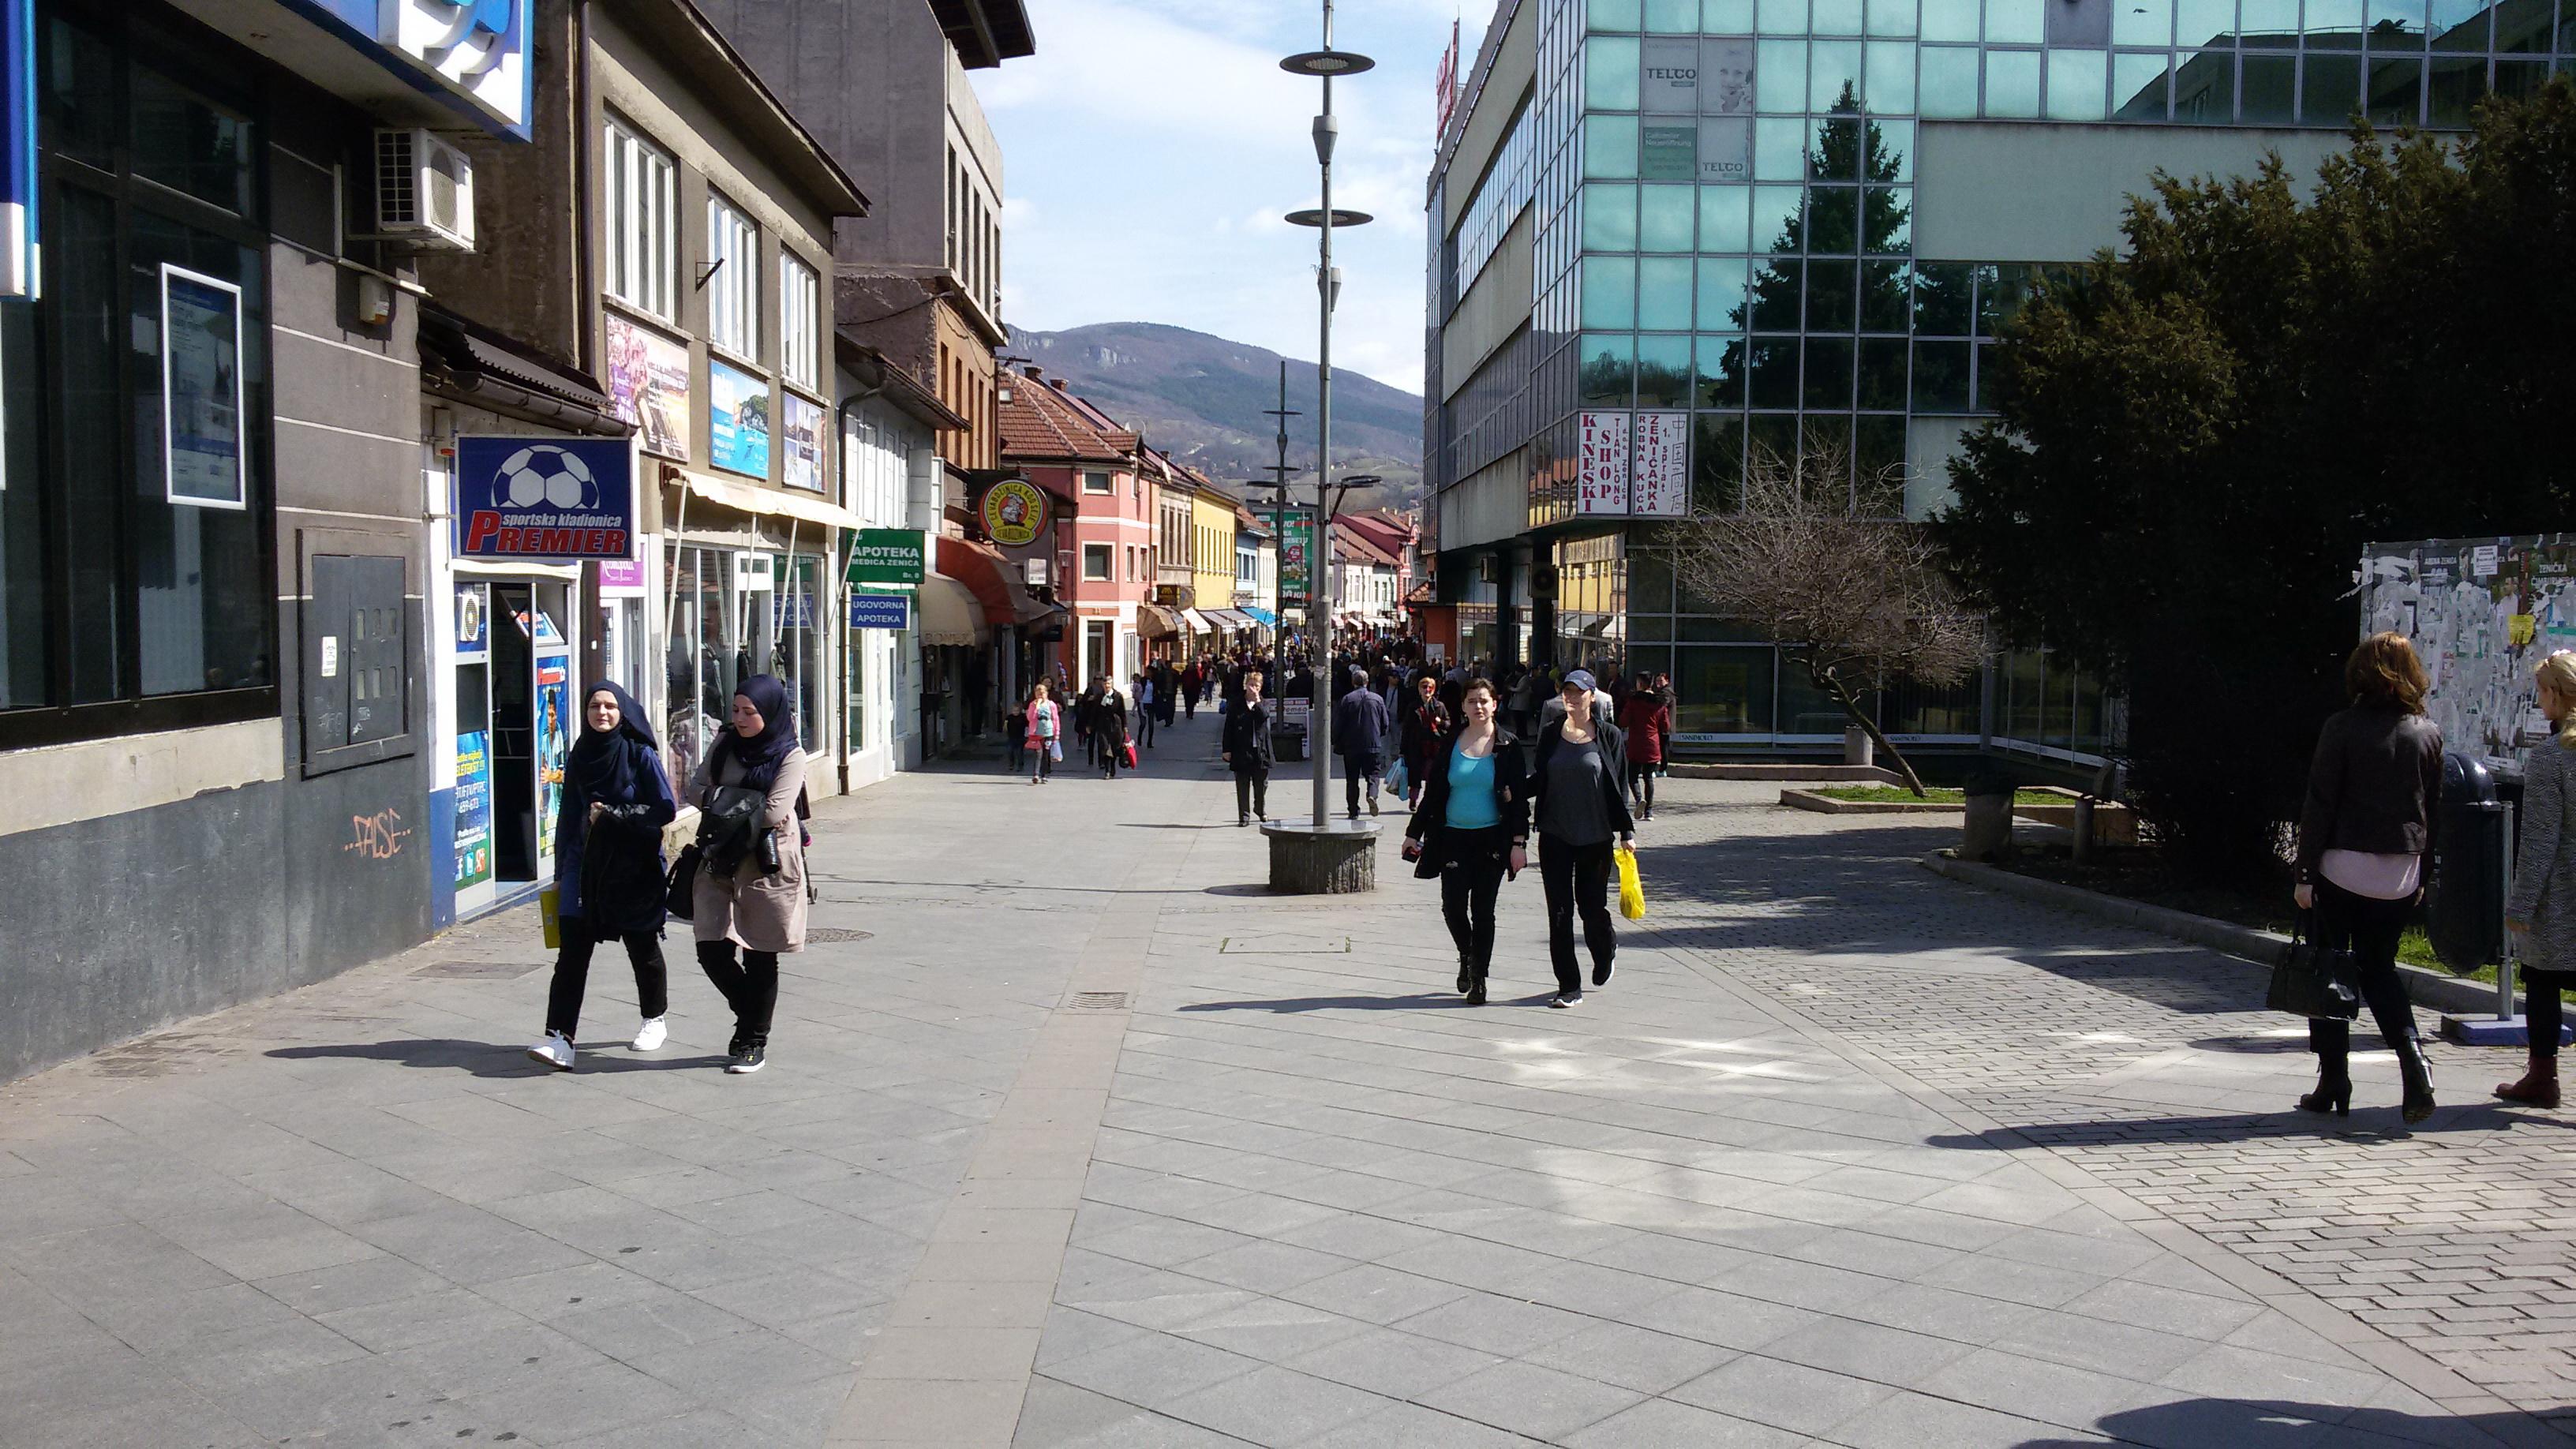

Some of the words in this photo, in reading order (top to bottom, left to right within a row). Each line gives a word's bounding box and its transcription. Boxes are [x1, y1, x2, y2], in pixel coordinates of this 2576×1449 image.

[1646, 68, 1696, 79] TELCO
[1703, 163, 1743, 171] TELCO
[1637, 416, 1646, 462] ROBNA
[1582, 414, 1597, 511] KINESKI
[1599, 429, 1611, 498] SHOP
[1647, 415, 1658, 511] ZENIČANKA
[503, 513, 556, 526] sportska
[557, 513, 622, 527] kladionica
[466, 510, 627, 554] PREMIER
[852, 545, 920, 558] APOTEKA
[852, 601, 905, 609] UGOVORNA
[856, 614, 900, 623] APOTEKA
